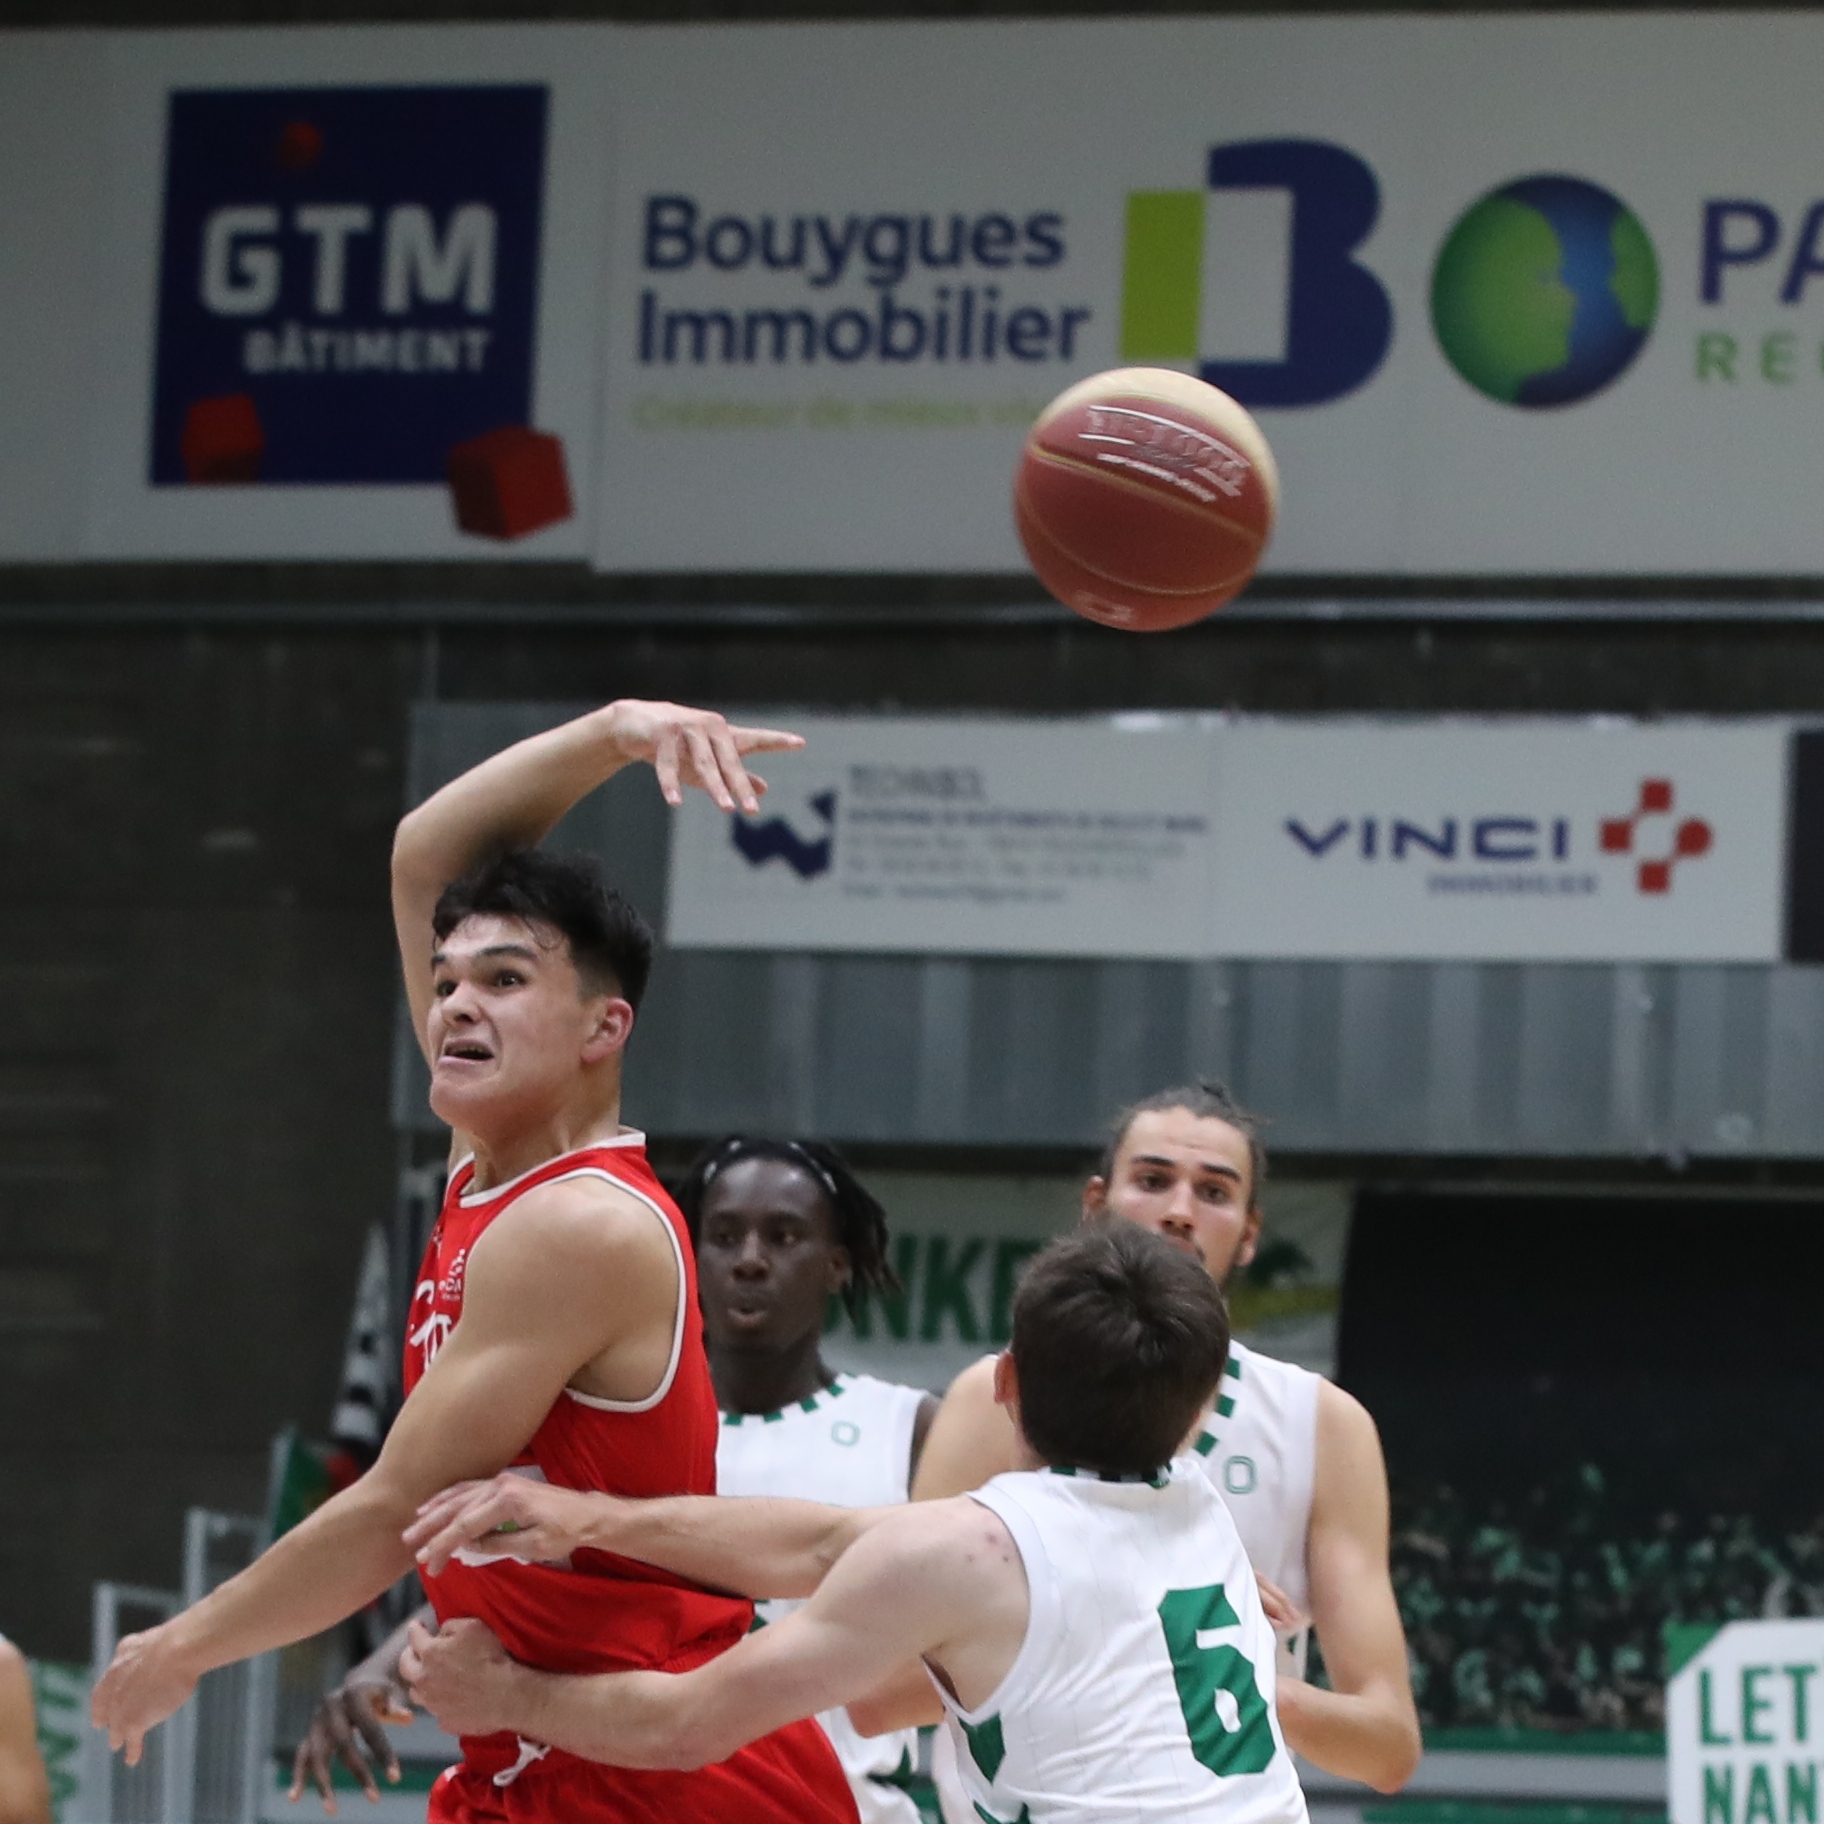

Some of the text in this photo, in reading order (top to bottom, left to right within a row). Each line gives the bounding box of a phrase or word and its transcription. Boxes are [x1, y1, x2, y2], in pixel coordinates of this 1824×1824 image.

[201, 202, 497, 316] GTM
[642, 195, 1067, 287] Bouygues
[243, 320, 491, 374] BÂTIMENT
[637, 285, 1092, 363] Immobilier
[1285, 817, 1569, 861] VINCI
[1157, 1583, 1276, 1778] 6
